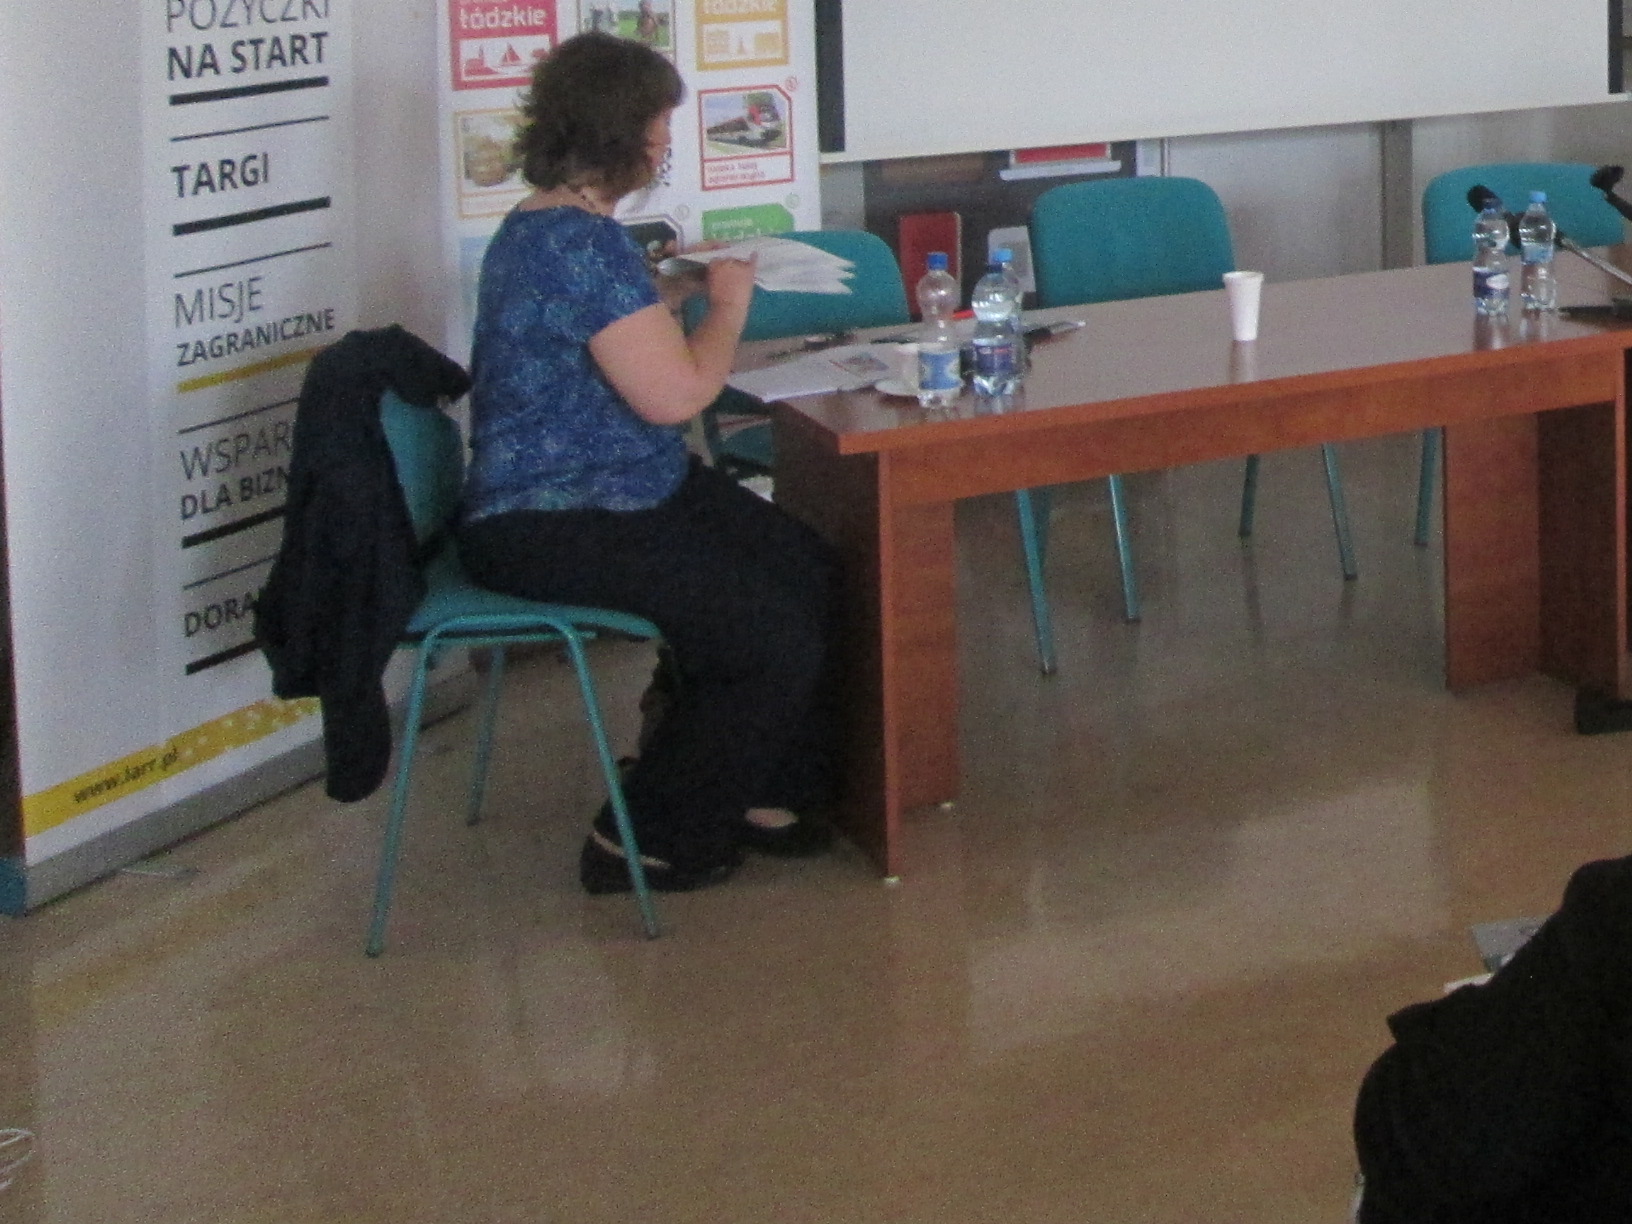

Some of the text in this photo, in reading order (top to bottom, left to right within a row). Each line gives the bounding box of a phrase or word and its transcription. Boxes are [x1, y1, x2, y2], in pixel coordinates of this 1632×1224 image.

[168, 32, 328, 80] NA START
[172, 152, 270, 198] TARGI
[174, 277, 262, 328] MISJE
[177, 309, 335, 366] ZAGRANICZNE
[181, 484, 233, 520] DLA
